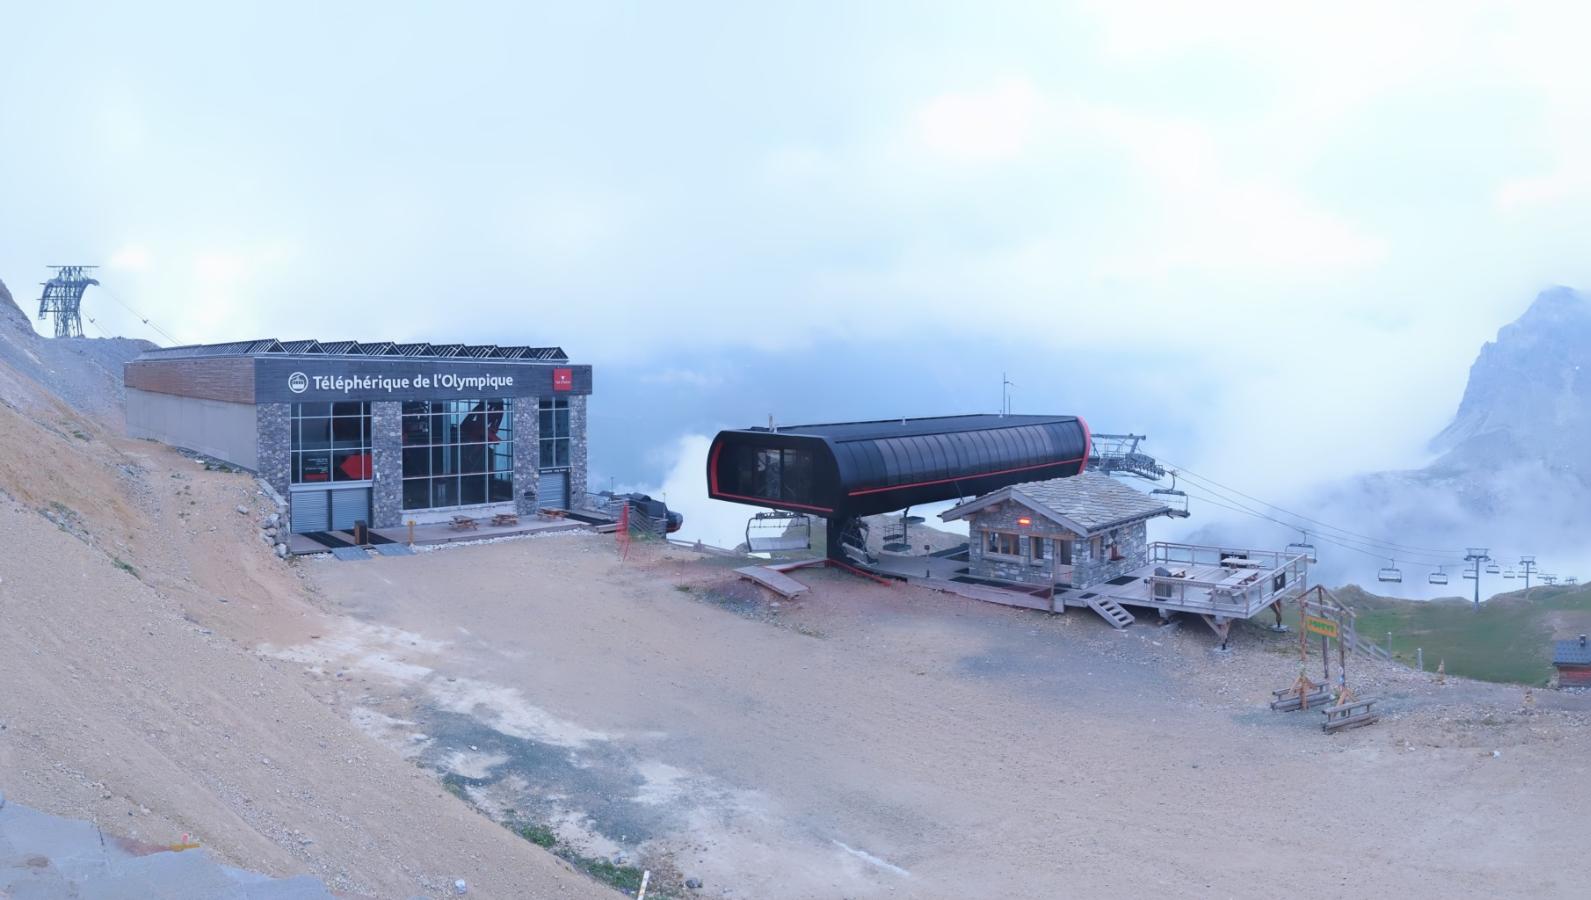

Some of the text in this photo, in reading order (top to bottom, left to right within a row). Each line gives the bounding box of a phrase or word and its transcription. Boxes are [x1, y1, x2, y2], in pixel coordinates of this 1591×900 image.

[312, 373, 513, 394] Téléphérique de l'Olympique
